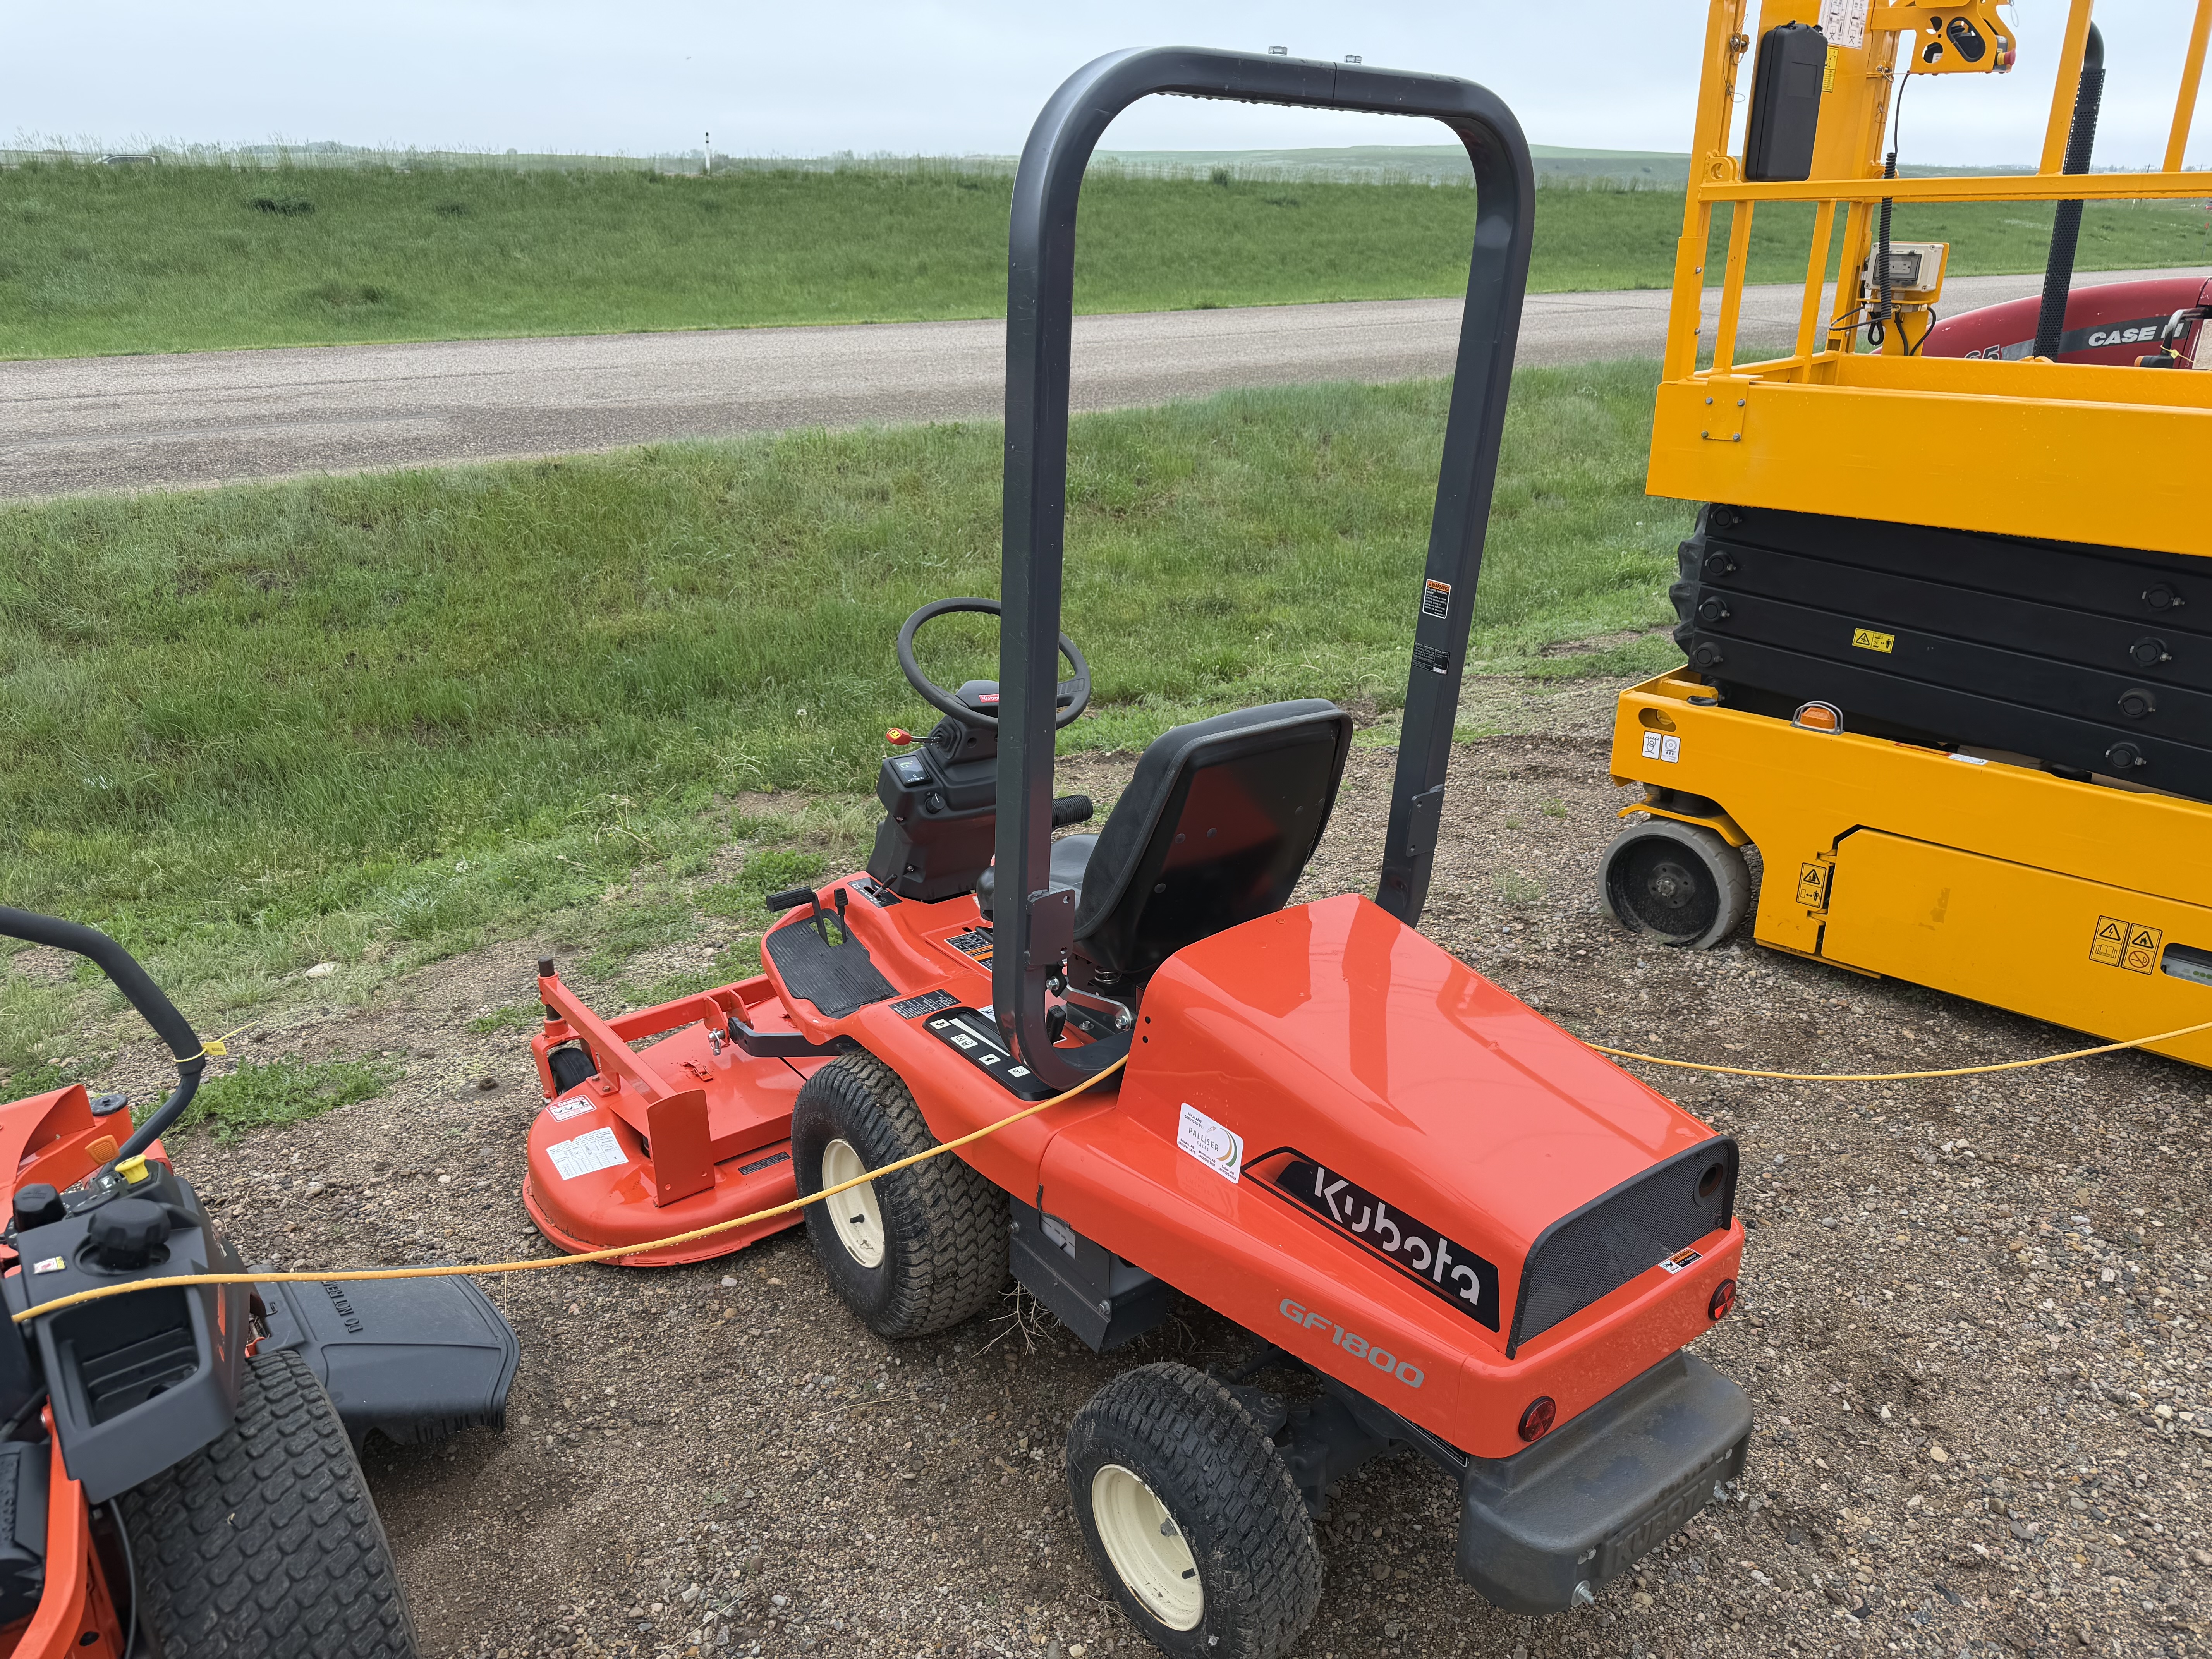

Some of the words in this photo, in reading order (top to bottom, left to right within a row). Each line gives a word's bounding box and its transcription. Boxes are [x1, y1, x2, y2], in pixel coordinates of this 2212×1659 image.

[2088, 326, 2157, 347] CASE
[1432, 582, 1449, 591] WARNING
[558, 1096, 585, 1107] DANGER
[1188, 1127, 1219, 1152] PALLISER
[1197, 1140, 1209, 1152] SALES
[1314, 1166, 1480, 1305] Kubota
[1675, 1249, 1693, 1260] WARNING
[321, 1279, 344, 1298] REM
[332, 1299, 354, 1316] NOT
[344, 1317, 364, 1333] DO
[1279, 1298, 1424, 1388] GF1800
